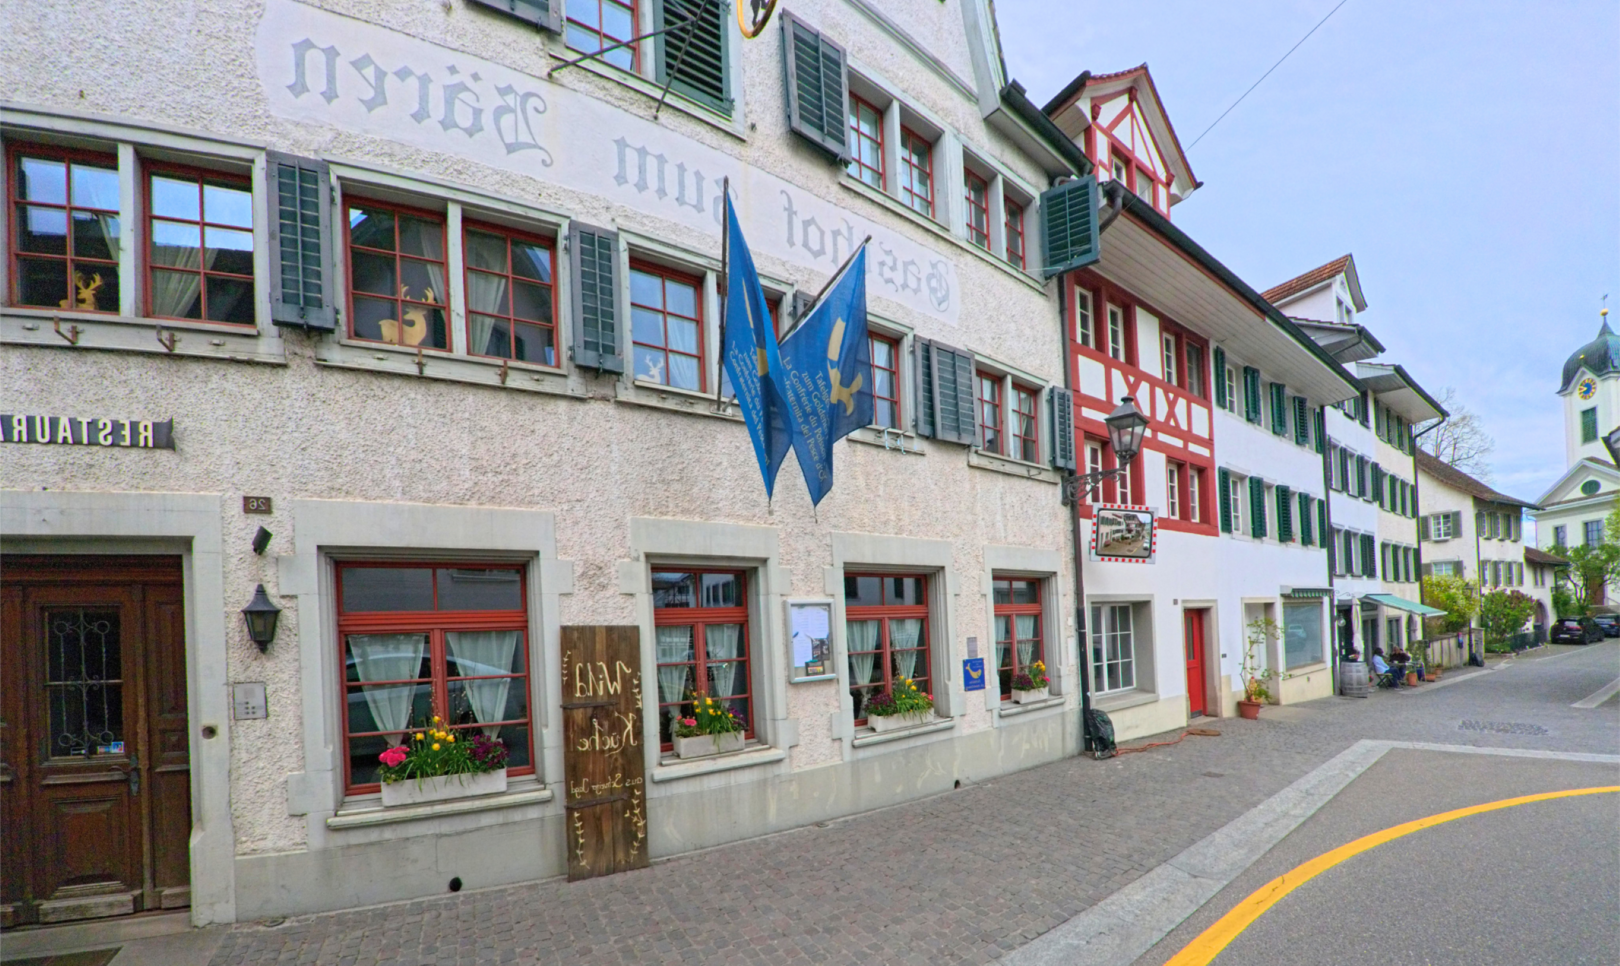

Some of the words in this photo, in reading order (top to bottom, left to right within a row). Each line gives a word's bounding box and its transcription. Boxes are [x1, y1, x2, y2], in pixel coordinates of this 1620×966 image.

[802, 371, 814, 392] zum
[782, 356, 793, 371] La
[790, 370, 812, 414] Confrérie
[809, 414, 818, 428] du
[814, 427, 827, 460] Poisson
[801, 424, 812, 438] del
[807, 437, 819, 462] Pesce
